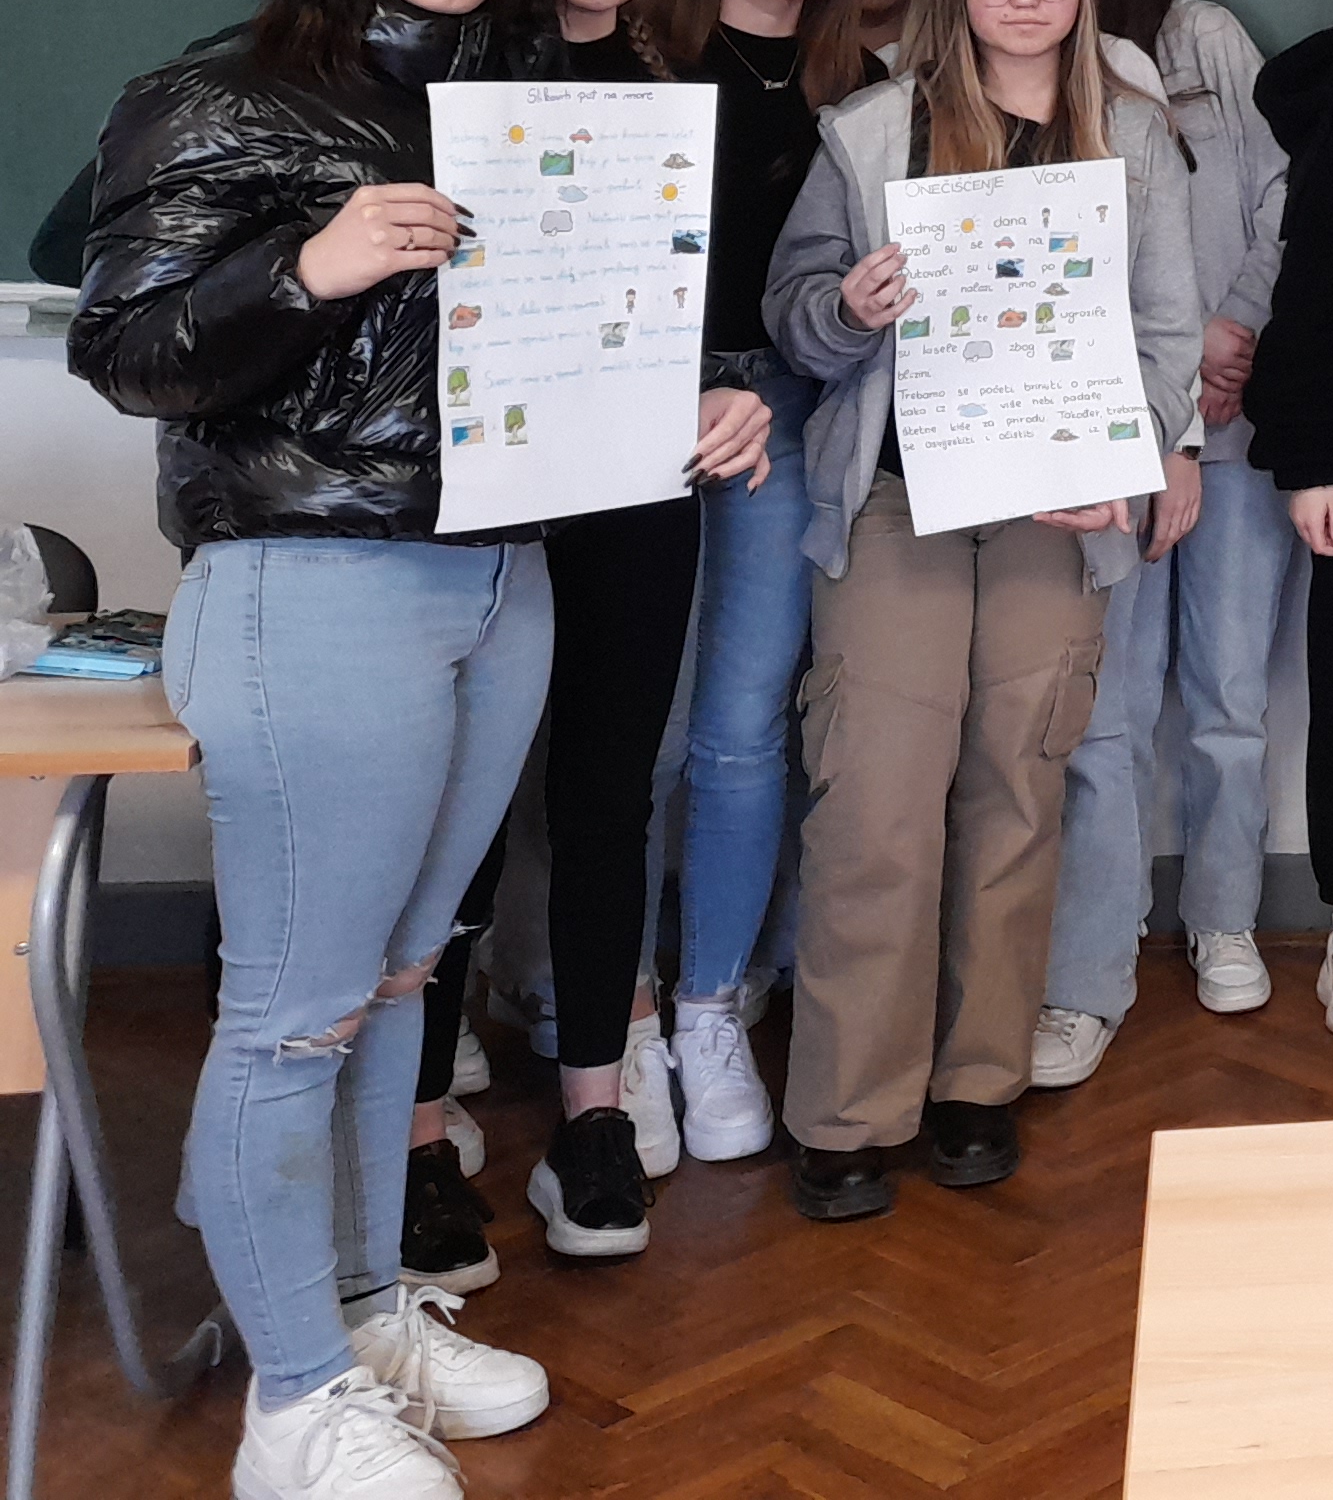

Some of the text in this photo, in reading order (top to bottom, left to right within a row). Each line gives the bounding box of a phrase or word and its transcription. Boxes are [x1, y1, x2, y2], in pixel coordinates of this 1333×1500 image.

[603, 92, 617, 100] na
[1032, 168, 1076, 185] VODA
[896, 222, 945, 241] Jednog
